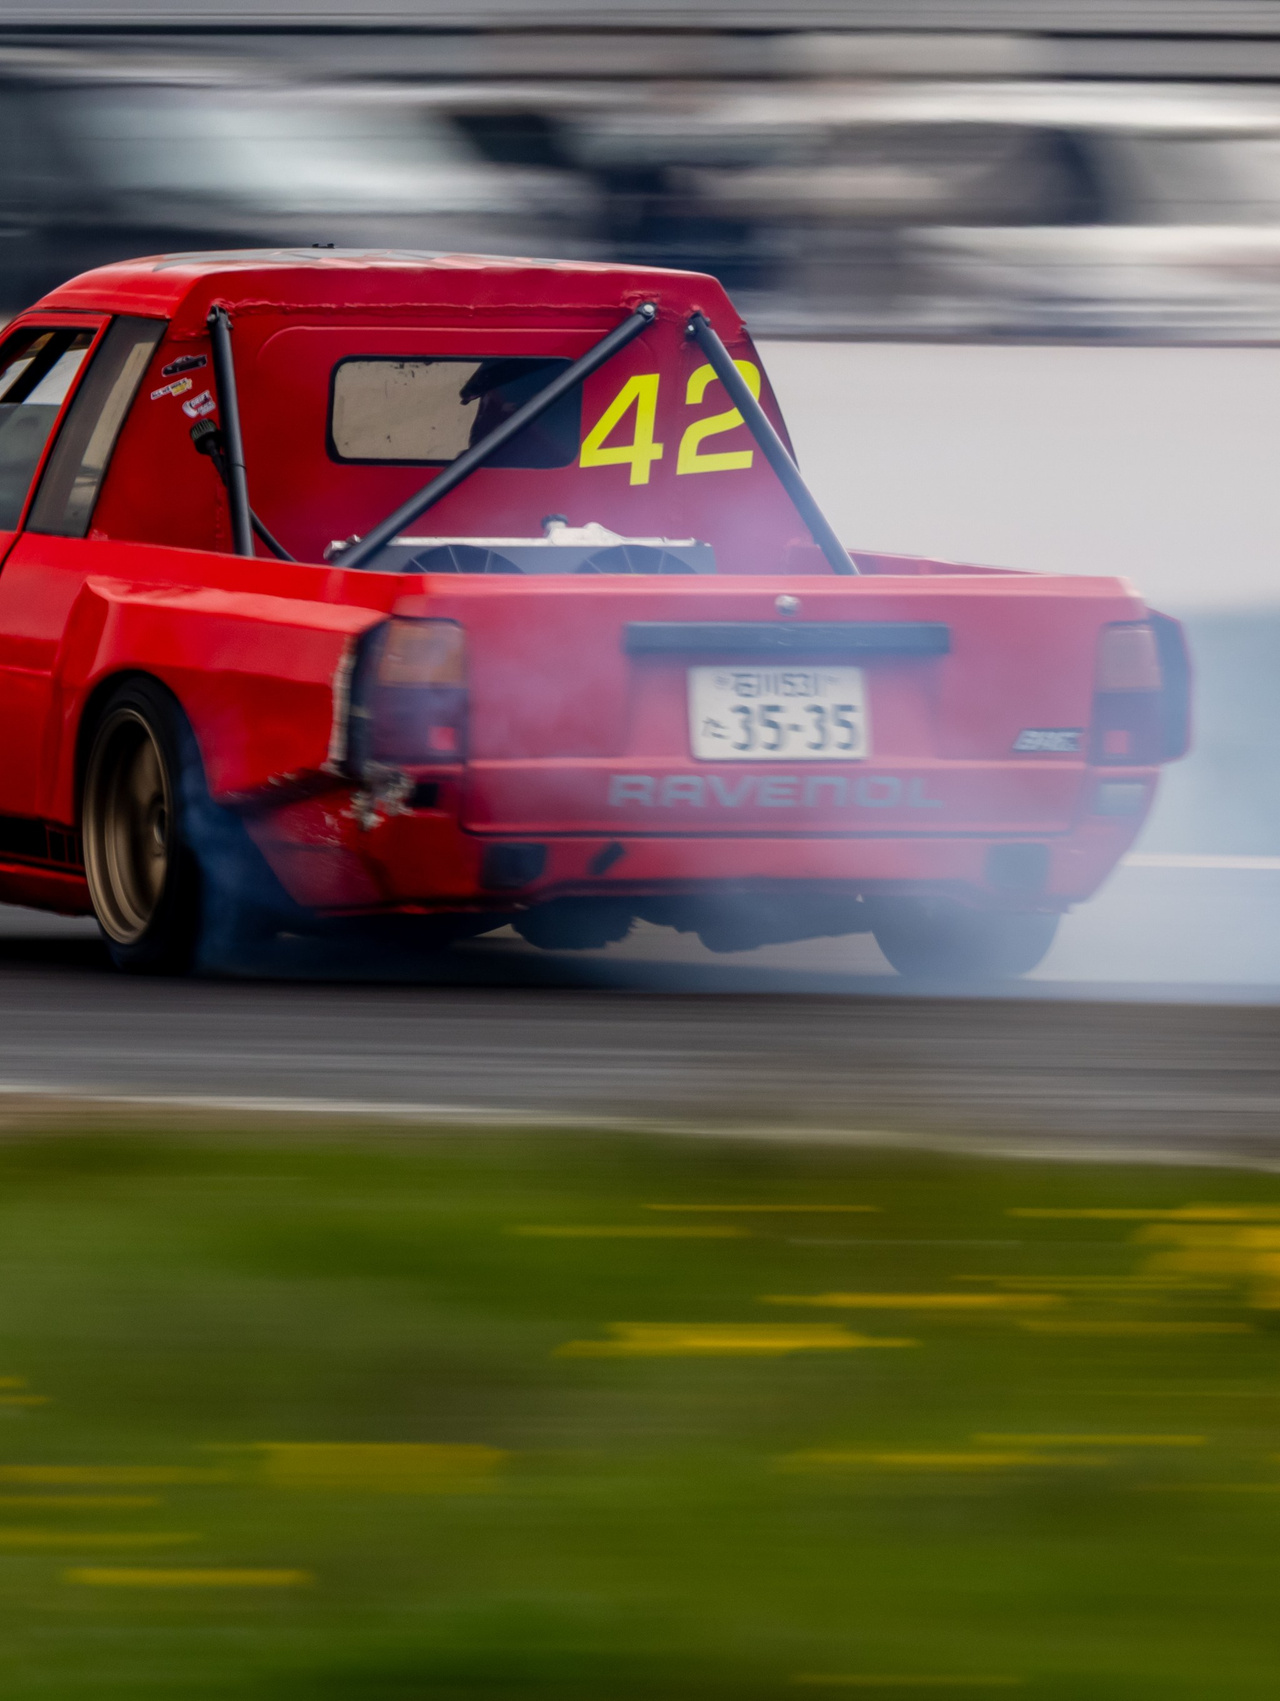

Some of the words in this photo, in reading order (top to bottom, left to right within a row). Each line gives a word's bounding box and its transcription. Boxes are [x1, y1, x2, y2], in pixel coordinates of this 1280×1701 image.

[579, 359, 761, 486] 42
[730, 703, 858, 751] 35-35
[608, 774, 943, 808] RAVENOL
